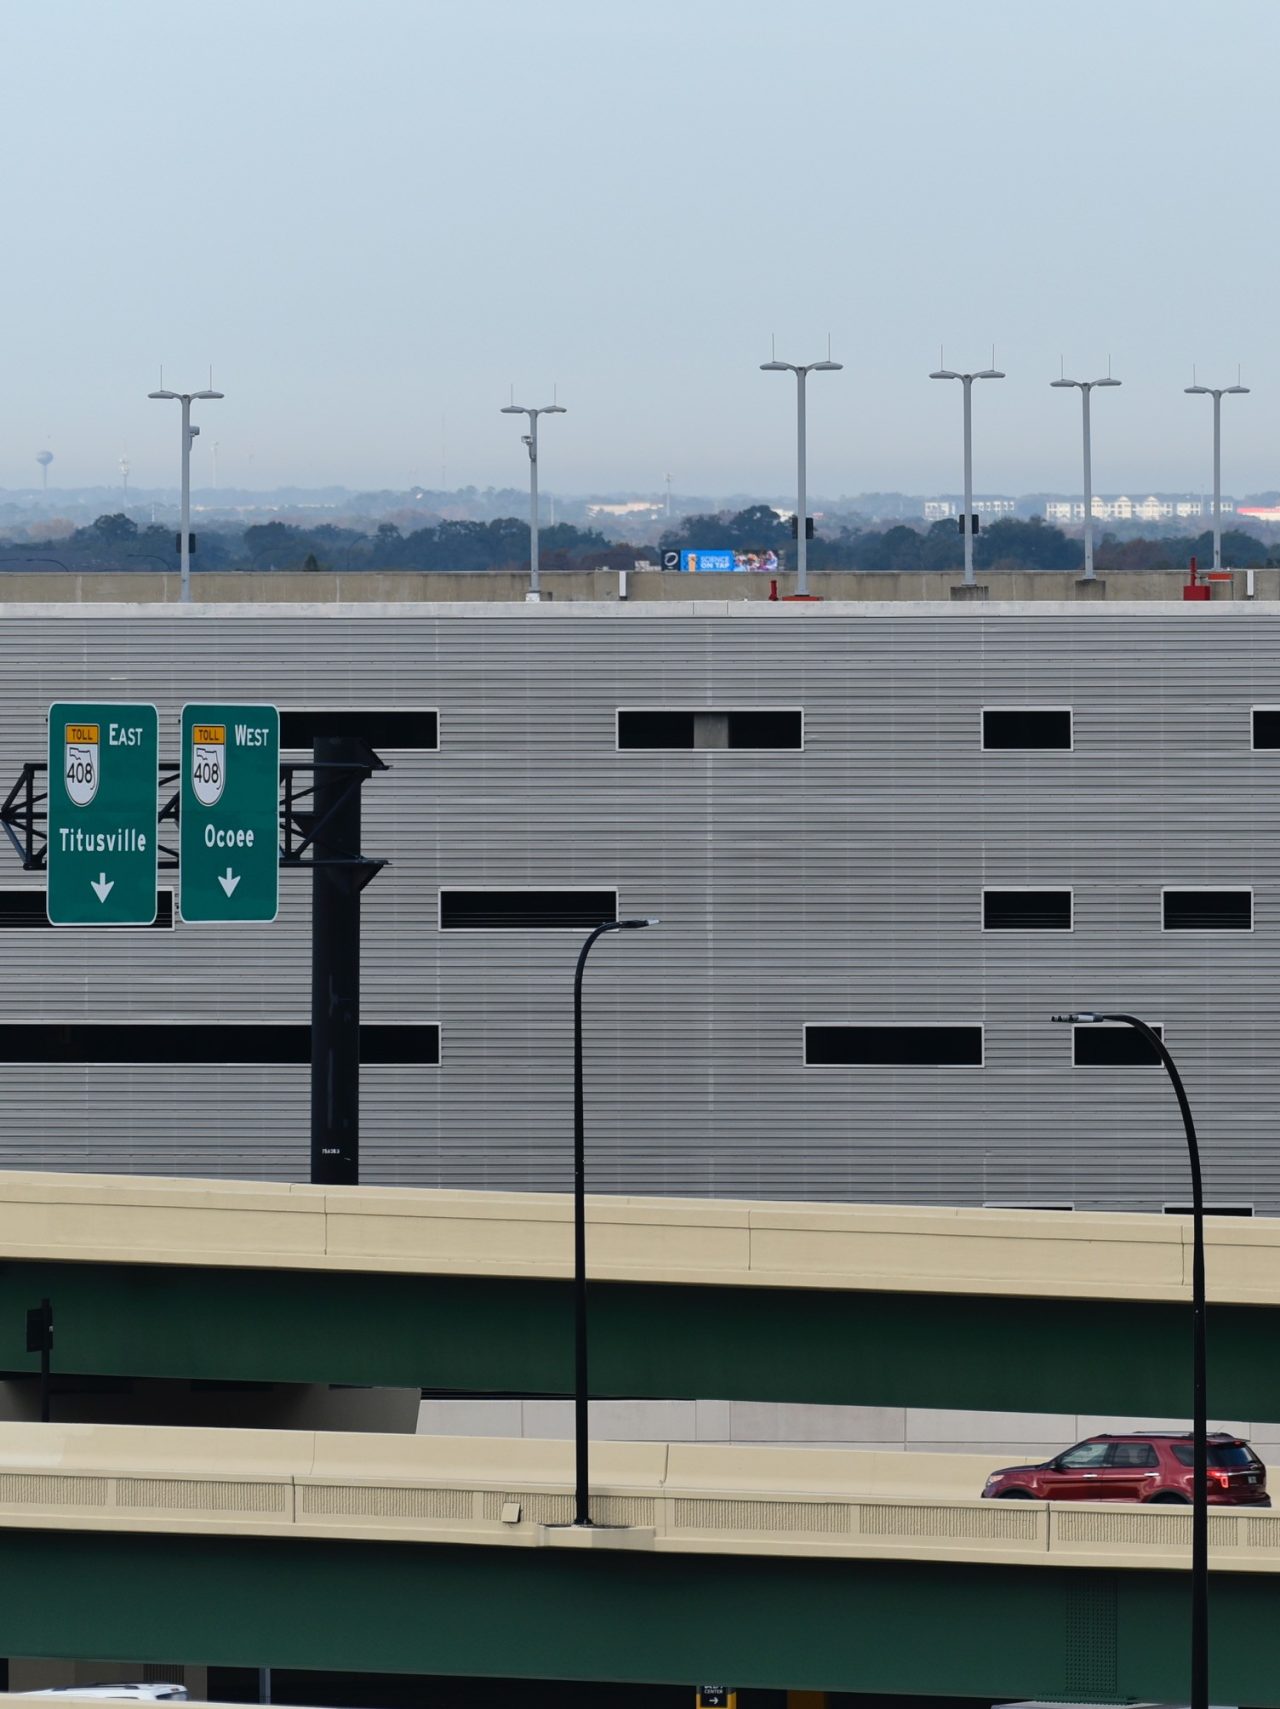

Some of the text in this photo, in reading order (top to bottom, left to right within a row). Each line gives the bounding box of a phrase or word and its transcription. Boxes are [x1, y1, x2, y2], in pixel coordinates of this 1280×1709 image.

[71, 728, 93, 741] TOLL
[198, 729, 220, 742] TOLL
[67, 763, 93, 784] 408
[194, 763, 219, 784] 408
[59, 828, 146, 852] Titusville
[204, 823, 255, 848] Ocoee
